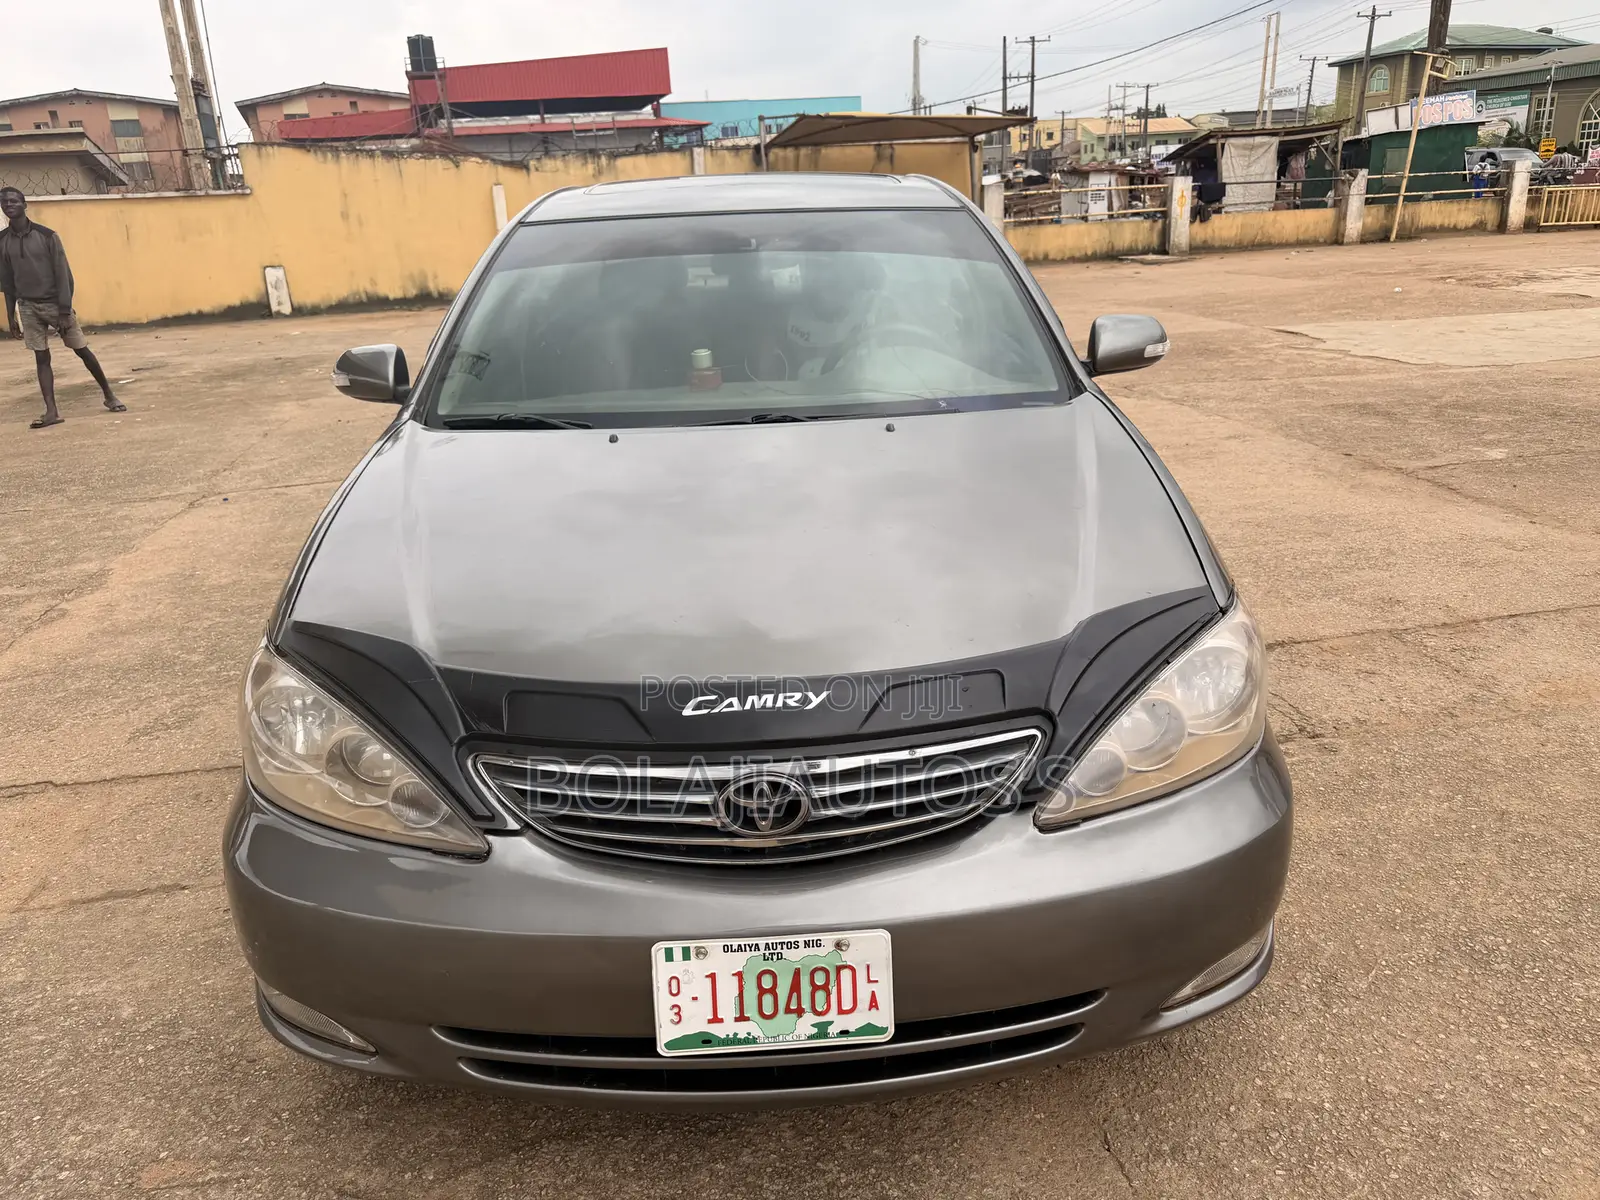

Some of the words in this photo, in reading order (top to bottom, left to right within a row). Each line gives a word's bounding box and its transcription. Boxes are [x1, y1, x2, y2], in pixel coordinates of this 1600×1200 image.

[1443, 98, 1474, 123] POS
[681, 690, 831, 716] CAMRY
[722, 943, 760, 954] OLAIYA
[763, 940, 800, 951] AUTOS
[803, 938, 825, 949] NIG.
[717, 1037, 753, 1046] FEDERAL
[754, 1034, 790, 1044] REPUBLIC
[792, 1033, 802, 1042] OF
[802, 1031, 836, 1041] NIGERIA
